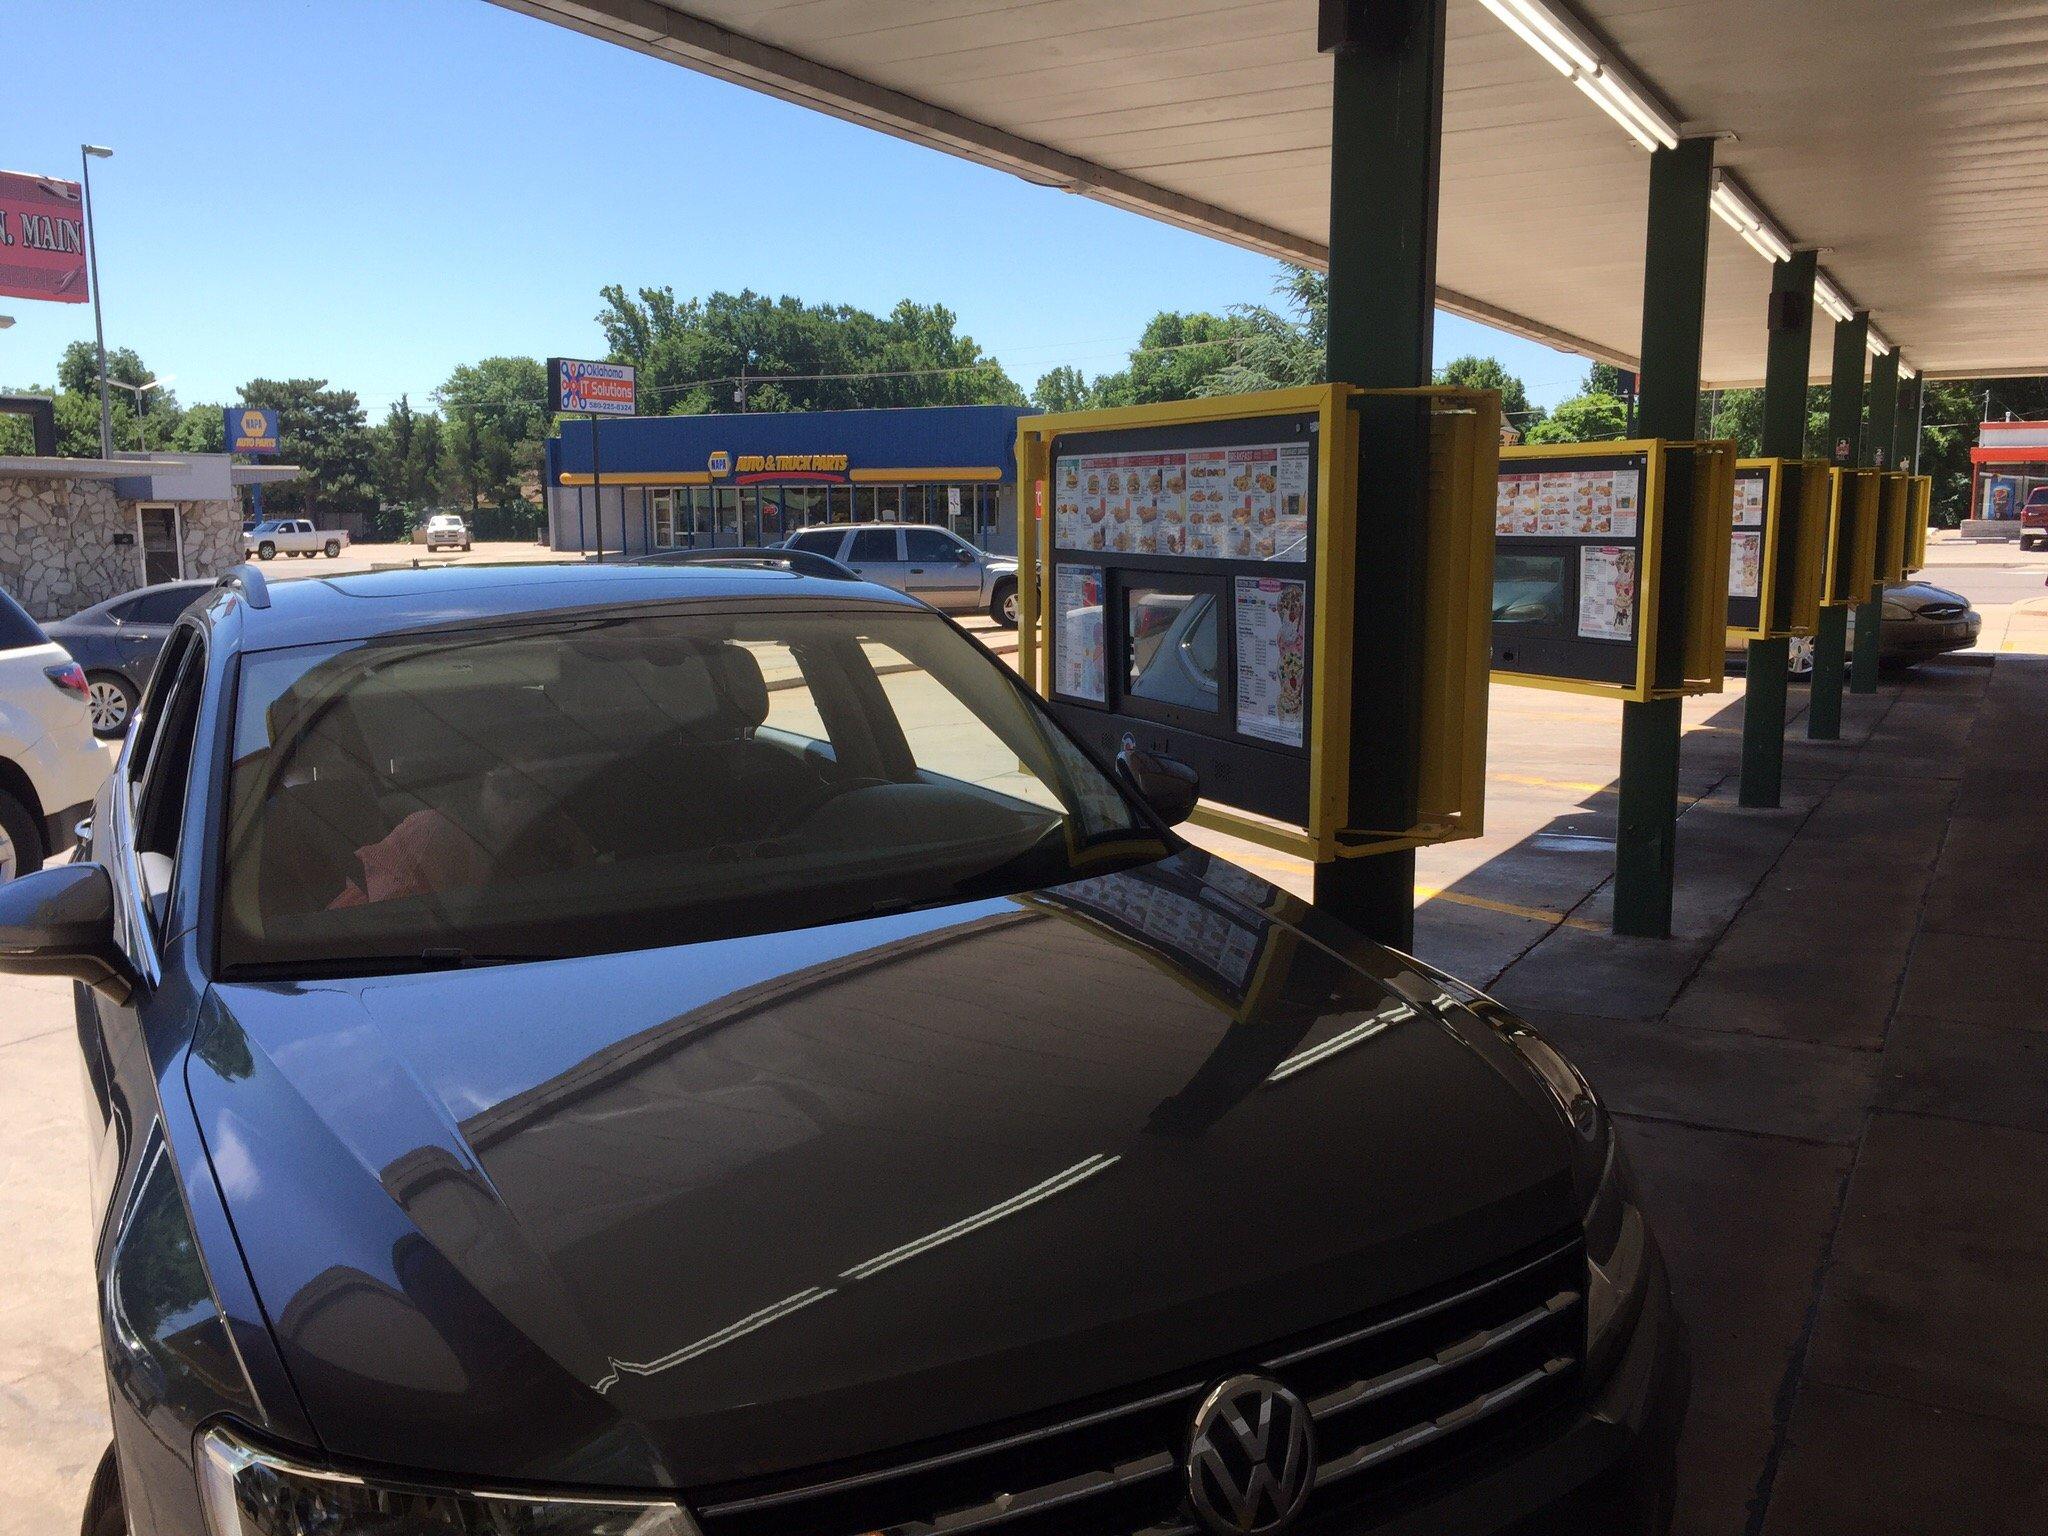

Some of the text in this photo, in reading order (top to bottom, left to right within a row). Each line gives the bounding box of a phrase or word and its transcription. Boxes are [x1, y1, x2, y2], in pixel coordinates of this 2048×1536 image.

[19, 212, 83, 255] MAIN
[586, 363, 624, 379] Oklahoma
[580, 380, 633, 399] IT Solutions
[236, 438, 277, 448] AUTO PARTS
[710, 459, 728, 470] NAPA
[735, 455, 848, 471] AUTO & TRUCK PARTS
